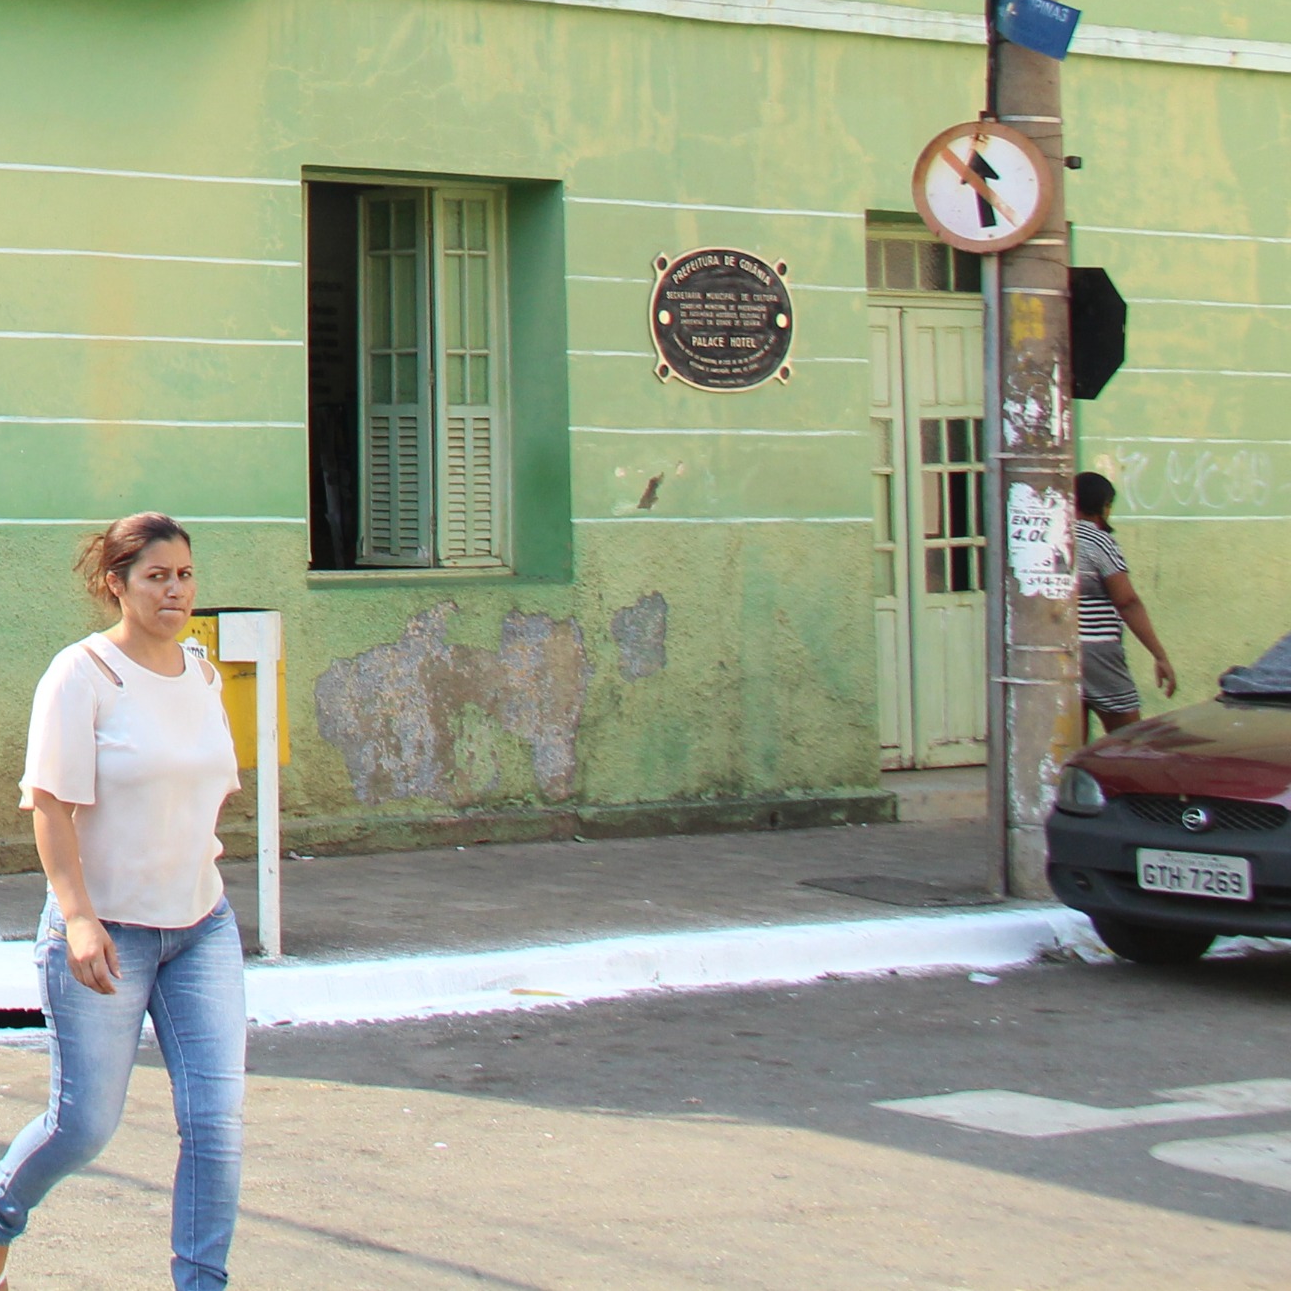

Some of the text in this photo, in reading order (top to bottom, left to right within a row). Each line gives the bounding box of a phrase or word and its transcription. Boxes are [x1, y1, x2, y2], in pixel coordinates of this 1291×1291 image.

[671, 255, 772, 286] PREFEITURA DE GOIÂNIA
[691, 336, 757, 349] PALACE HOTEL
[1143, 863, 1243, 894] GTH-7269
